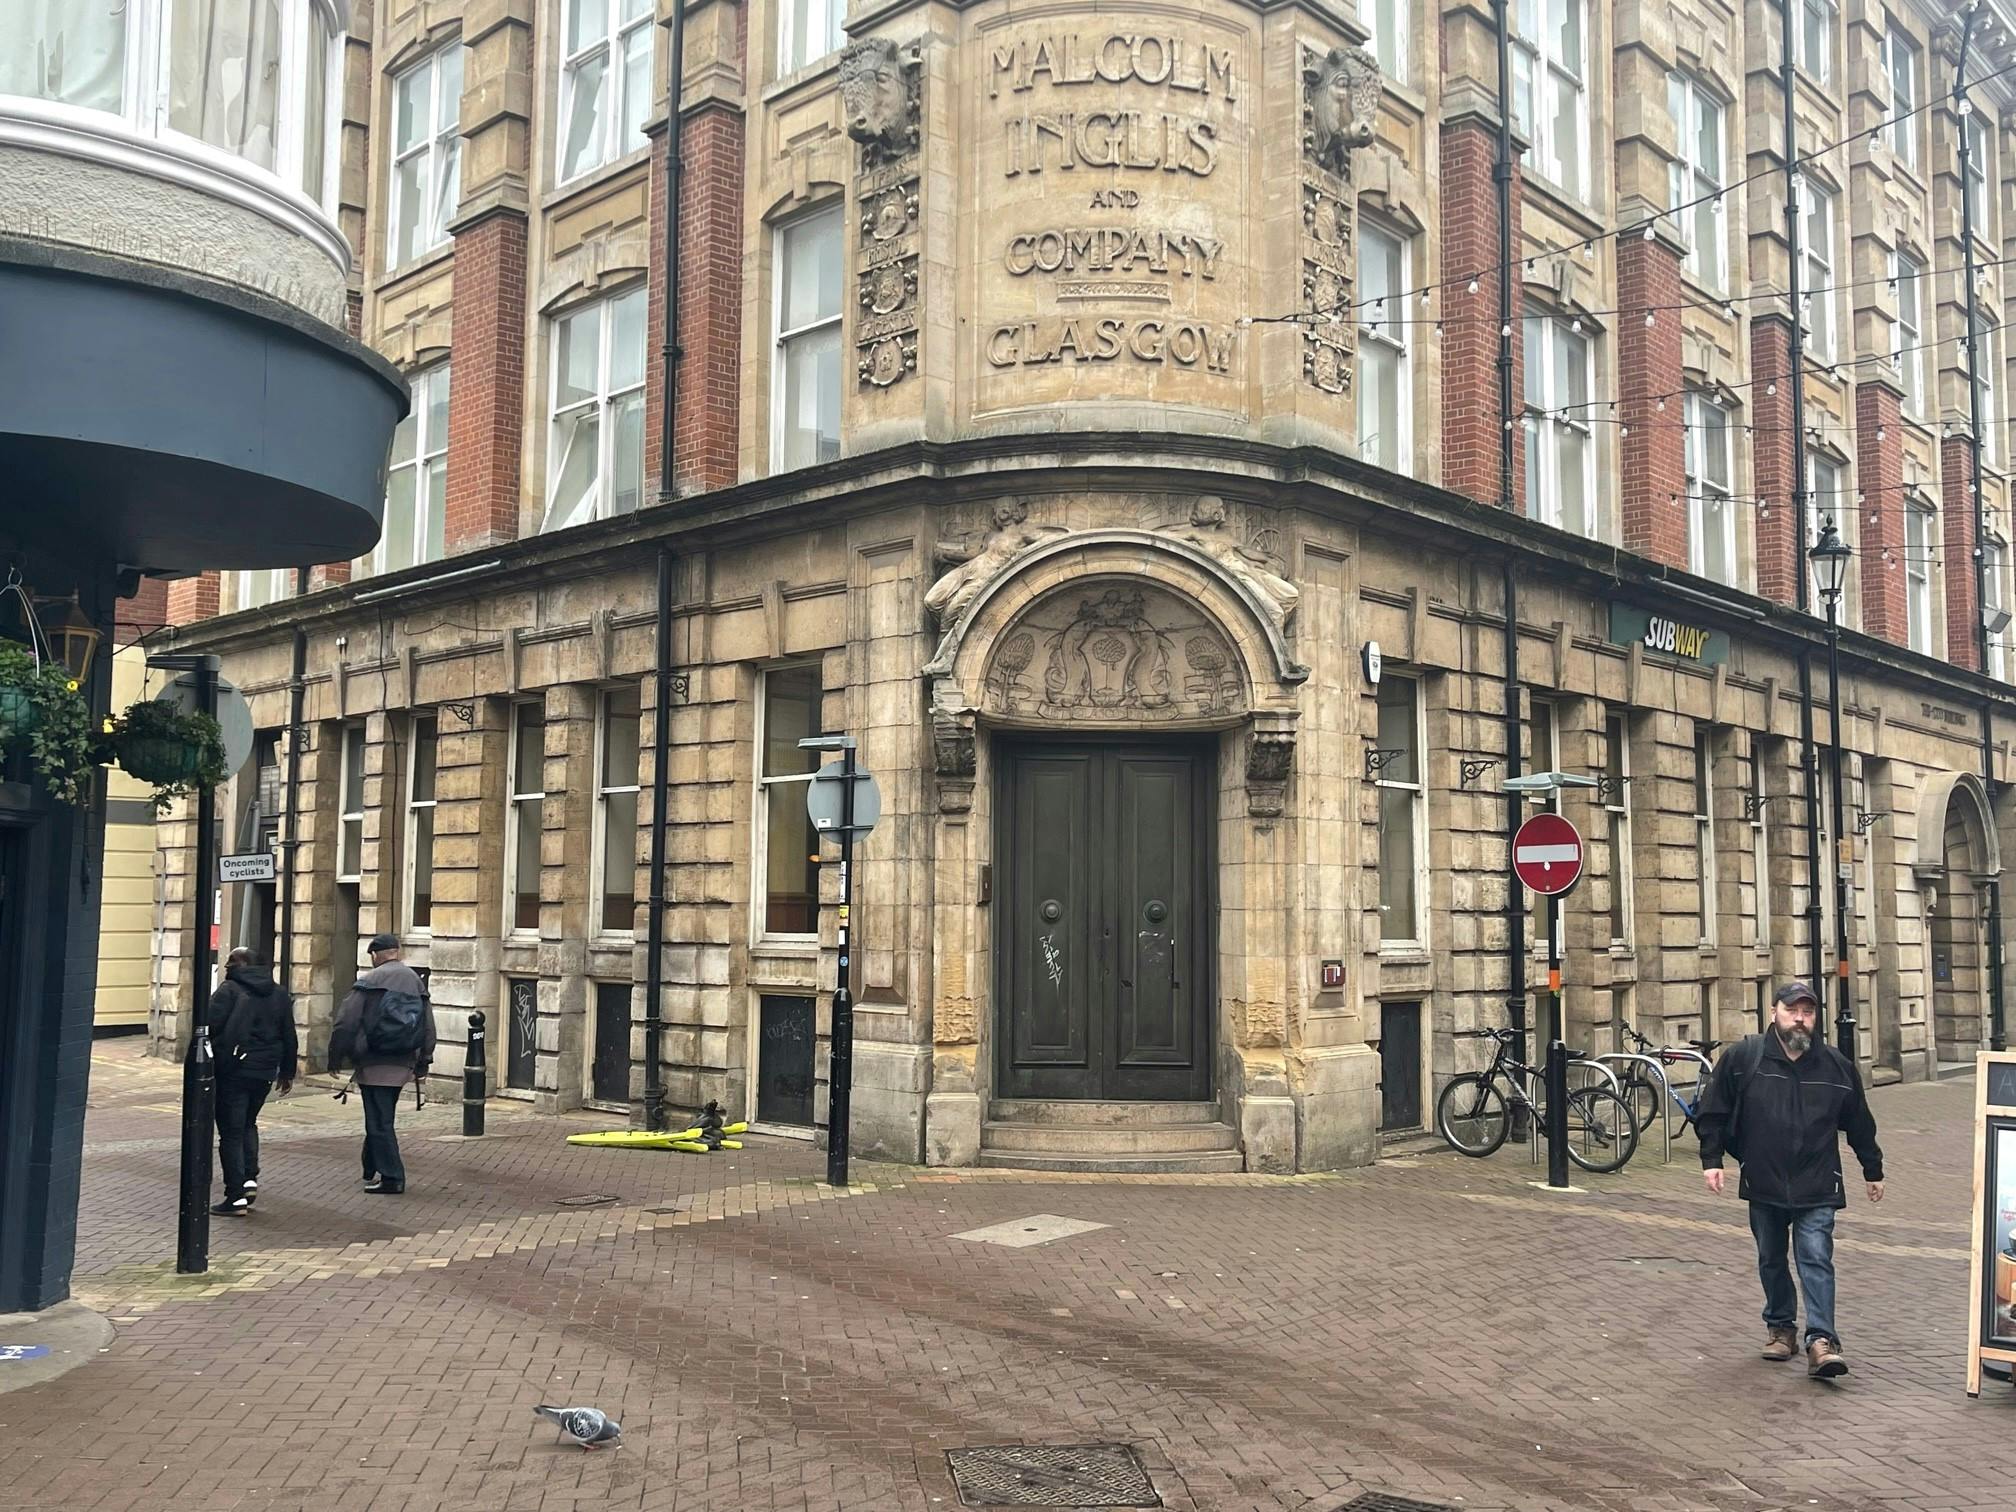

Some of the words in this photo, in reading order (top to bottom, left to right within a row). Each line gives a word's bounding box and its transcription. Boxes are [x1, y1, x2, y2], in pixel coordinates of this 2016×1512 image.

[990, 35, 1236, 102] MALCOLM
[1005, 112, 1218, 177] INGLIS
[1089, 190, 1140, 209] AND
[1004, 228, 1224, 280] COMPANY
[987, 319, 1239, 372] GLASGOW
[1644, 616, 1711, 660] SUBWAY
[223, 858, 270, 868] Oncoming
[229, 868, 265, 878] cyclists
